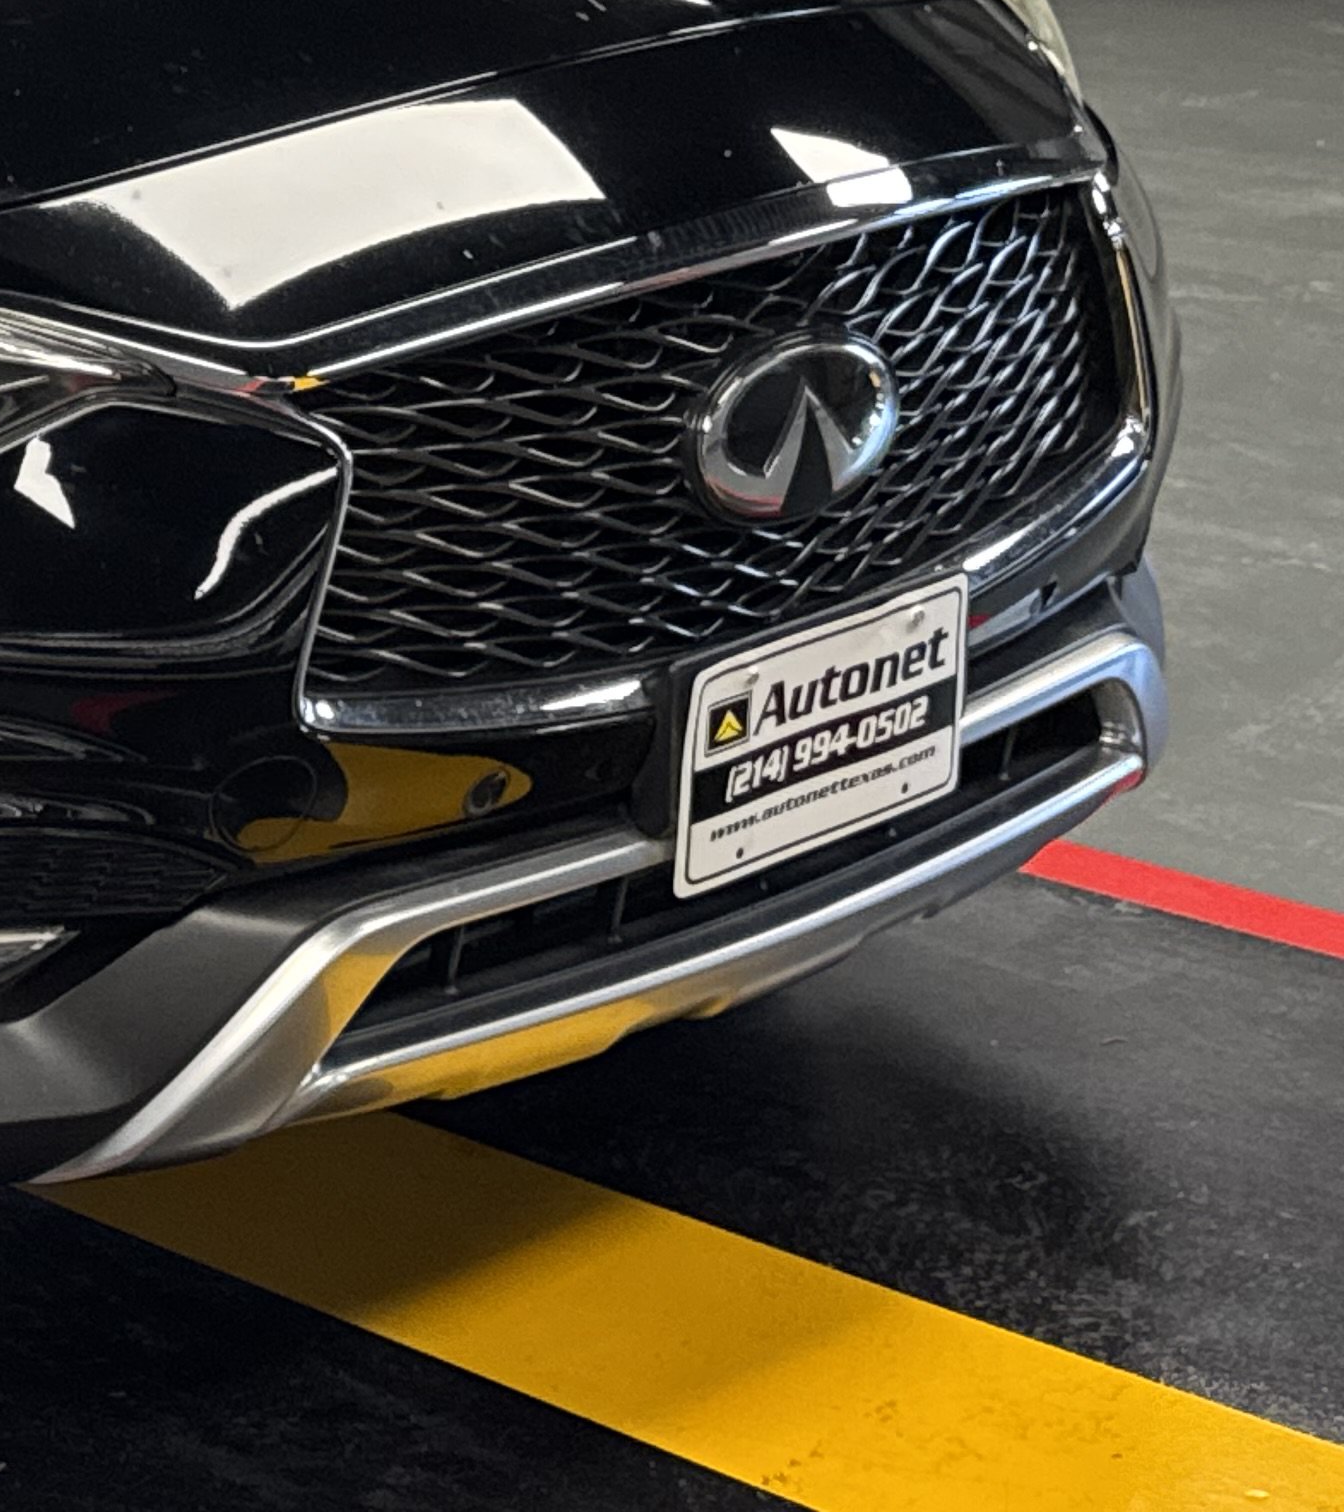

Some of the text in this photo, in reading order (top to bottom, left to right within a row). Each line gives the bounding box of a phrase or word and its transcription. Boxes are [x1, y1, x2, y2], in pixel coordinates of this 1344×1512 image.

[753, 626, 950, 736] Autonet
[725, 695, 929, 804] (214) 994-0502
